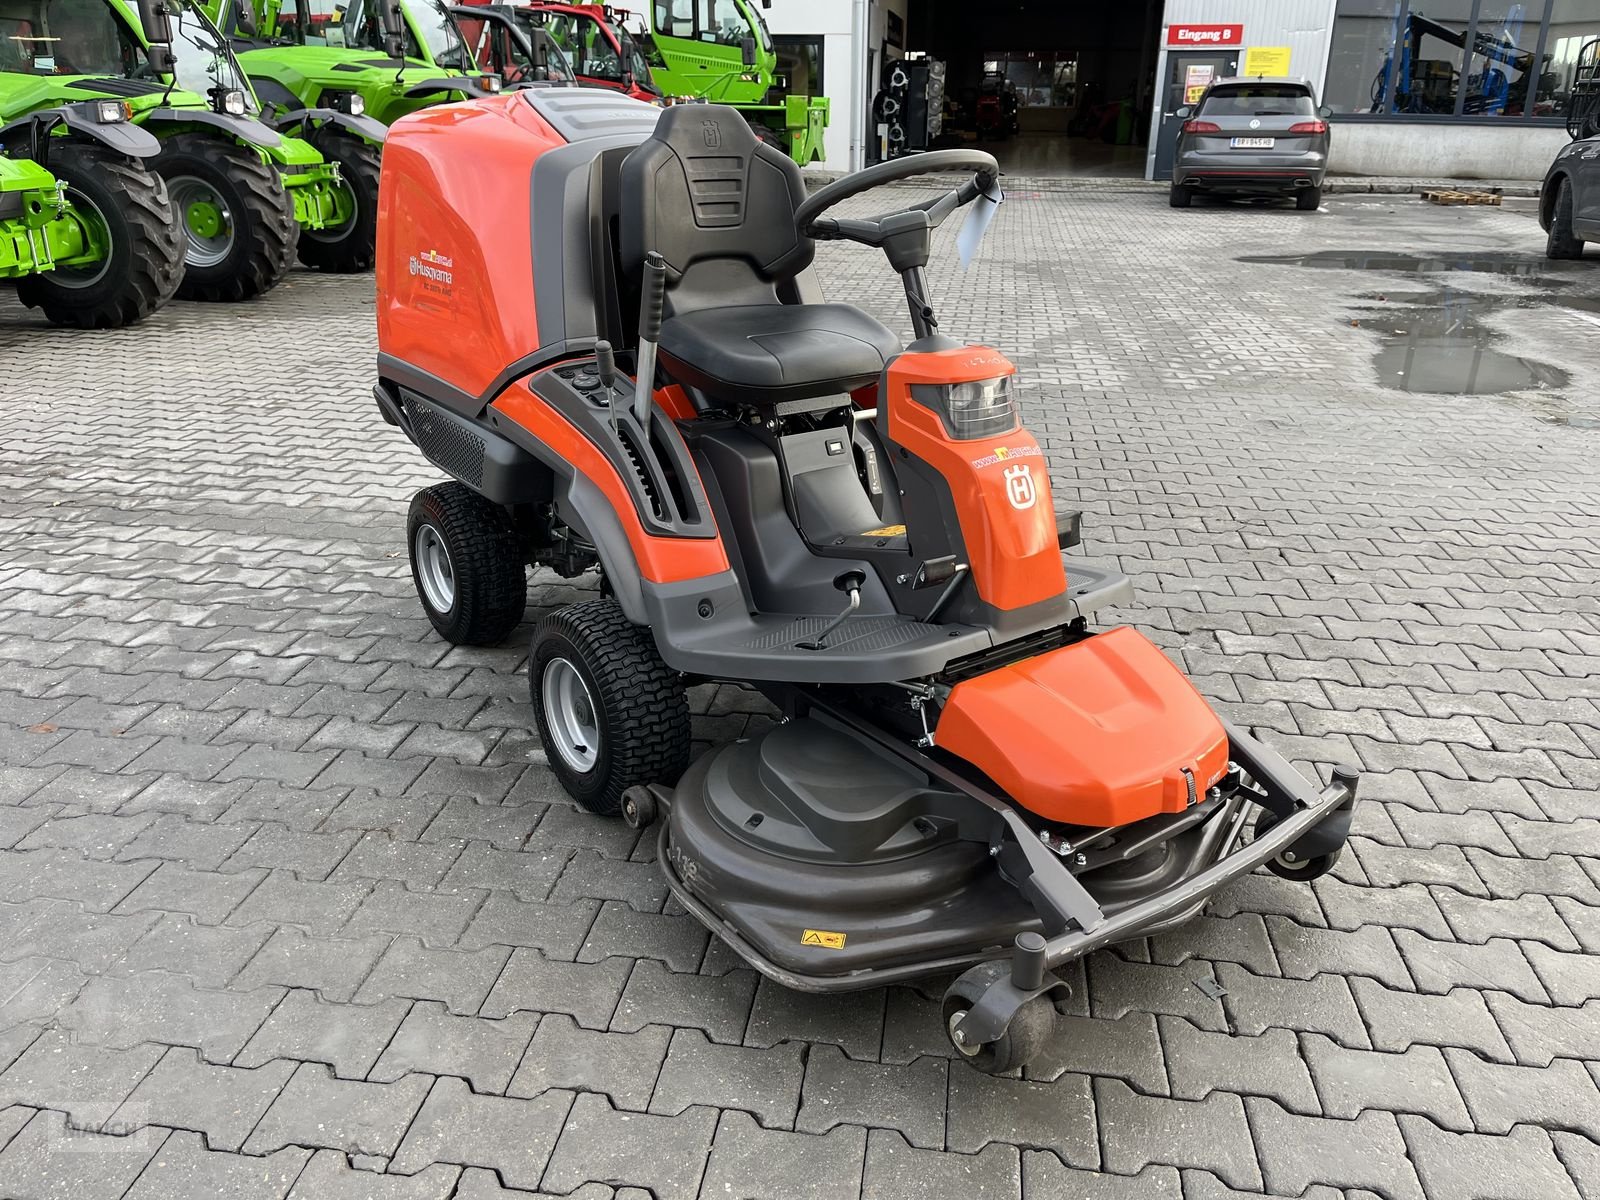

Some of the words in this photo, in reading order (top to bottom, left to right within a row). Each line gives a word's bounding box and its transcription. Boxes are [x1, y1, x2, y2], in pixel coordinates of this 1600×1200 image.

[1178, 29, 1221, 41] Eingang
[1223, 29, 1231, 39] B
[417, 260, 452, 284] Husqvarna
